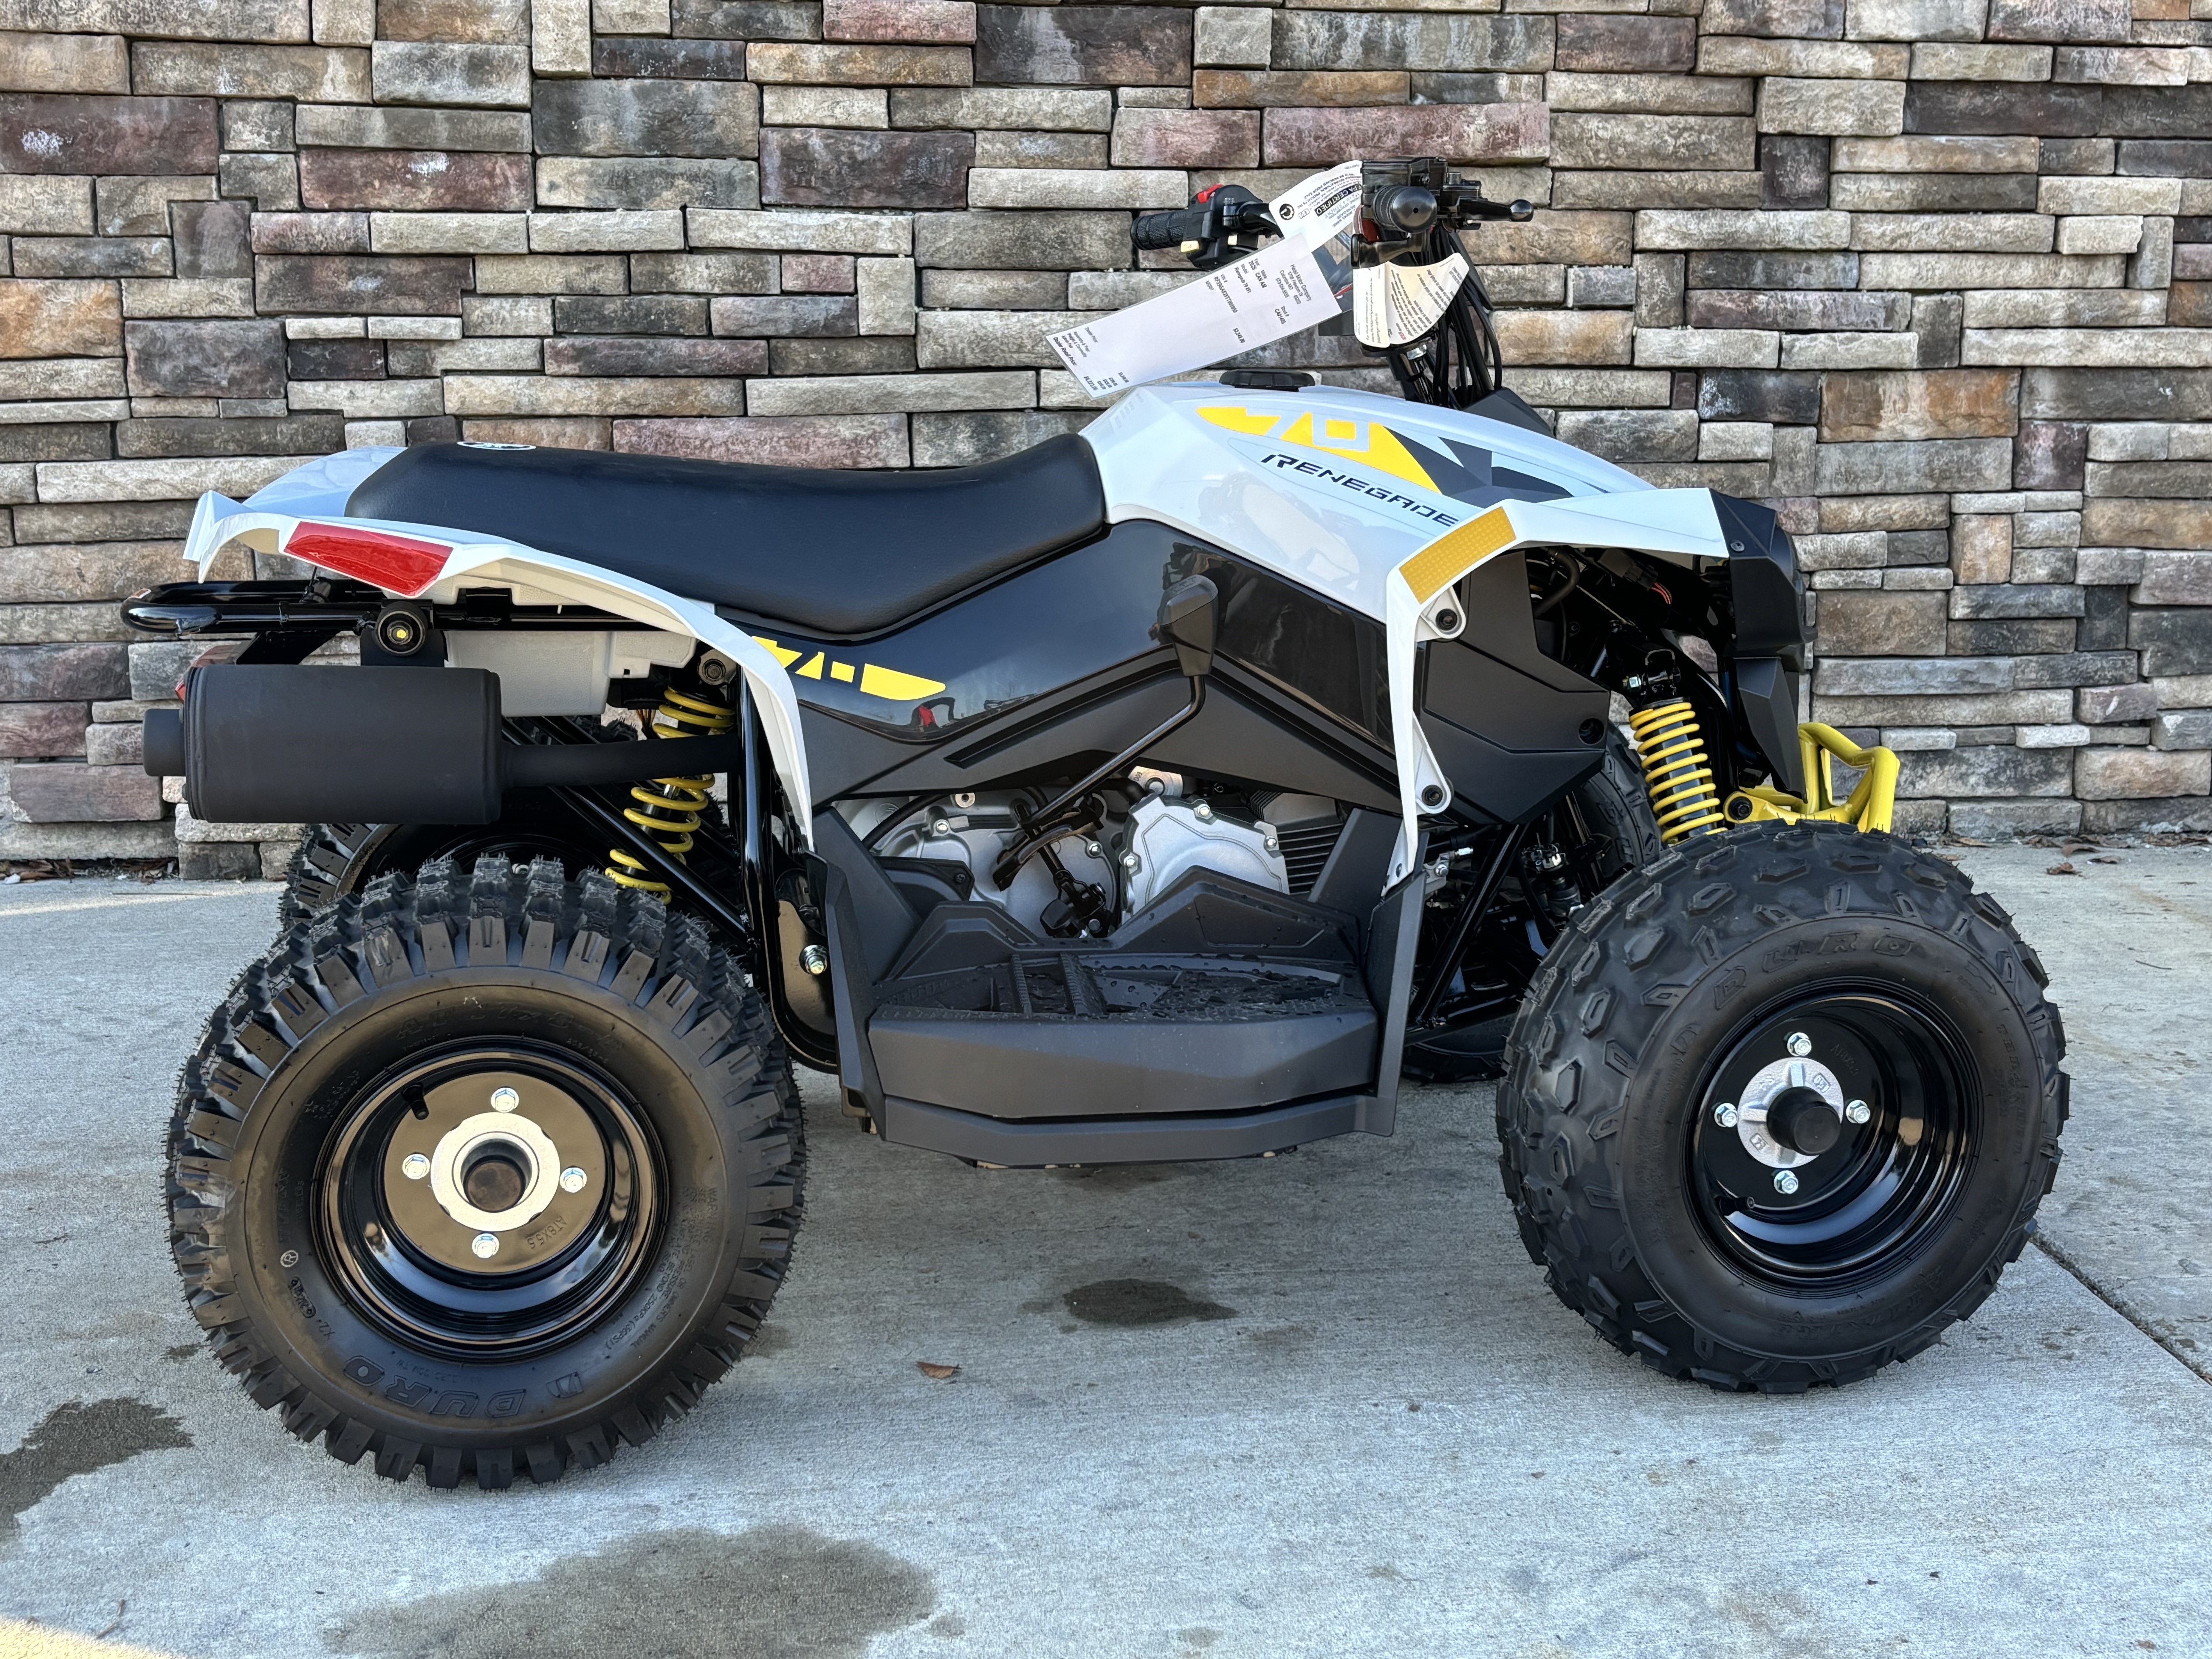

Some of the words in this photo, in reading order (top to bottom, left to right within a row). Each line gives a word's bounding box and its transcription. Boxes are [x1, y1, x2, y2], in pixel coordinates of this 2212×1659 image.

[1316, 190, 1348, 214] CERTIFIED
[1290, 264, 1298, 275] Head
[1295, 274, 1304, 285] Motor
[1301, 284, 1312, 301] Company
[1261, 454, 1460, 527] RENEGADE
[343, 1354, 526, 1419] DURO
